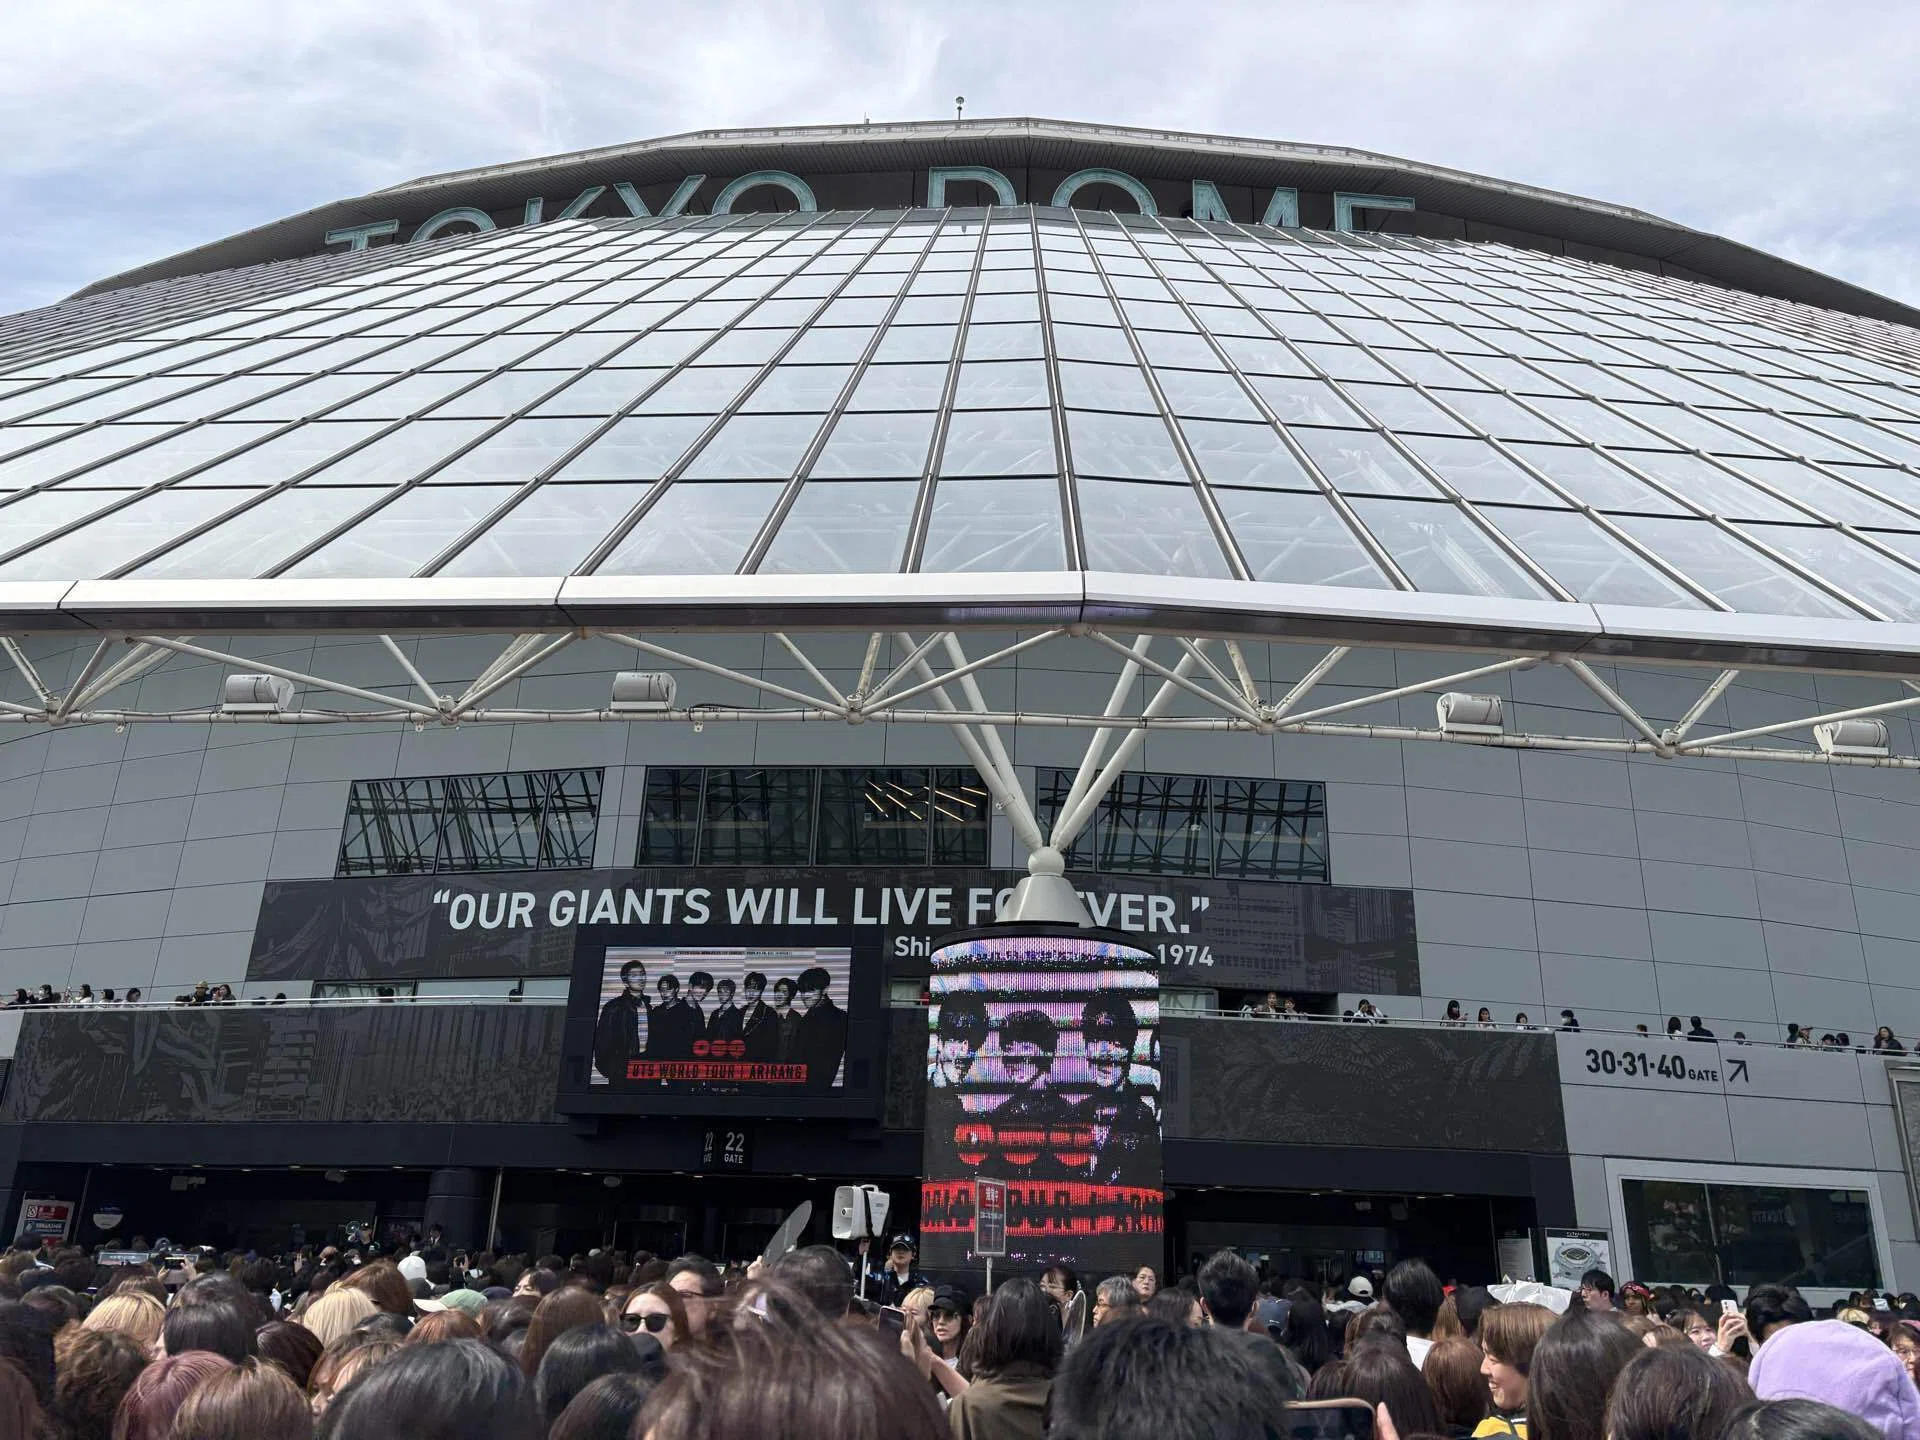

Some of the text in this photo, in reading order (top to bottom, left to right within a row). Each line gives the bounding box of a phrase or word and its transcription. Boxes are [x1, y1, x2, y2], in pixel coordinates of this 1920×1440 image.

[548, 888, 712, 927] GIANTS
[726, 887, 838, 925] WILL
[853, 887, 953, 925] LIVE
[967, 887, 1210, 934] FVER.”
[1157, 943, 1214, 967] 1974
[659, 1063, 700, 1079] WORLD
[704, 1064, 735, 1080] TOUR
[1688, 1068, 1719, 1082] GATE
[725, 1131, 745, 1152] 22
[724, 1153, 744, 1164] GATE
